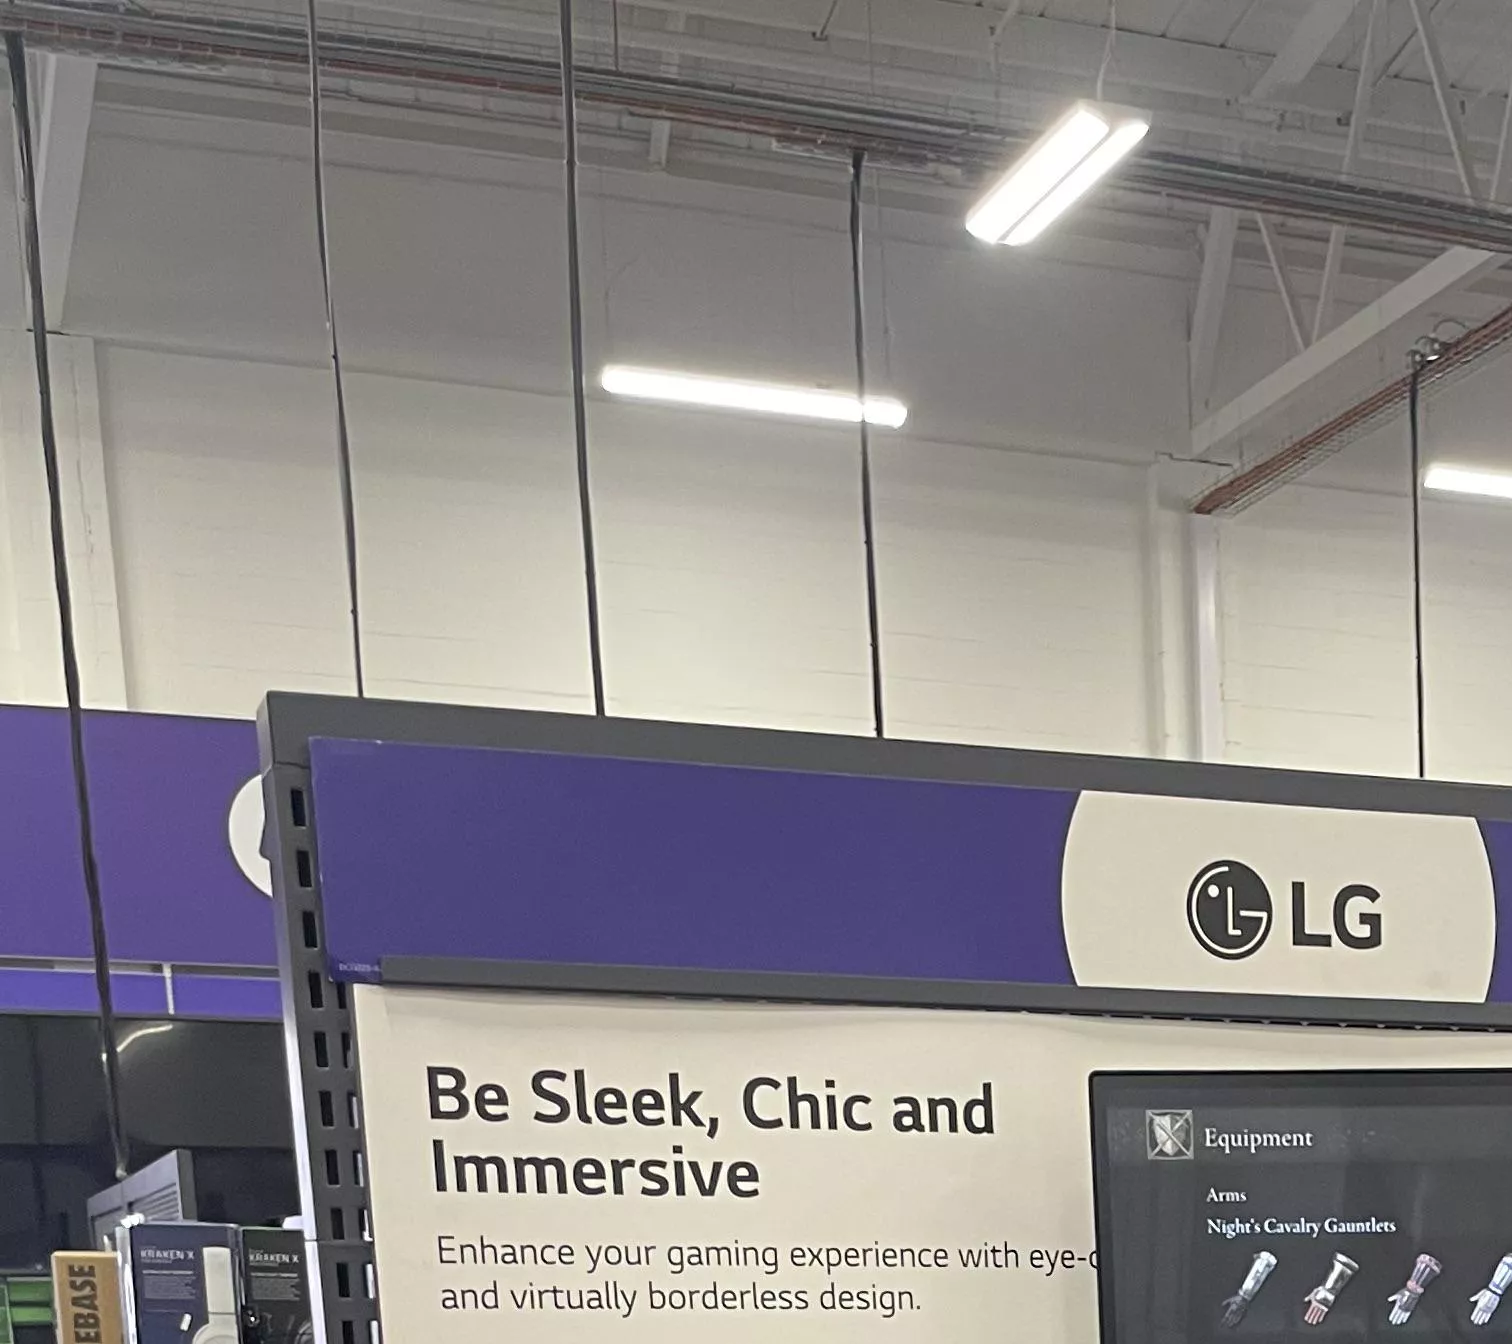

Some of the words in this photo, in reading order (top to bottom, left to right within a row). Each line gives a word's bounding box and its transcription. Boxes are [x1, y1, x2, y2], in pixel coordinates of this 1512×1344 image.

[1291, 881, 1382, 950] LG
[427, 1064, 510, 1122] Be
[531, 1069, 721, 1140] Sleek,
[742, 1075, 874, 1133] Chic
[891, 1081, 995, 1135] and
[1204, 1127, 1313, 1150] Equipment
[431, 1138, 761, 1198] Immersive
[1207, 1188, 1247, 1203] Arms
[1207, 1218, 1261, 1237] Night's
[1263, 1217, 1321, 1238] Cavalry
[1324, 1217, 1396, 1235] Gauntlets
[437, 1235, 576, 1267] Enhance
[585, 1240, 657, 1273] your
[667, 1237, 779, 1274] gaming
[789, 1239, 949, 1274] experience
[958, 1241, 1020, 1269] with
[441, 1283, 500, 1311] and
[509, 1283, 637, 1318] virtually
[648, 1282, 809, 1312] borderless
[818, 1284, 922, 1318] design.
